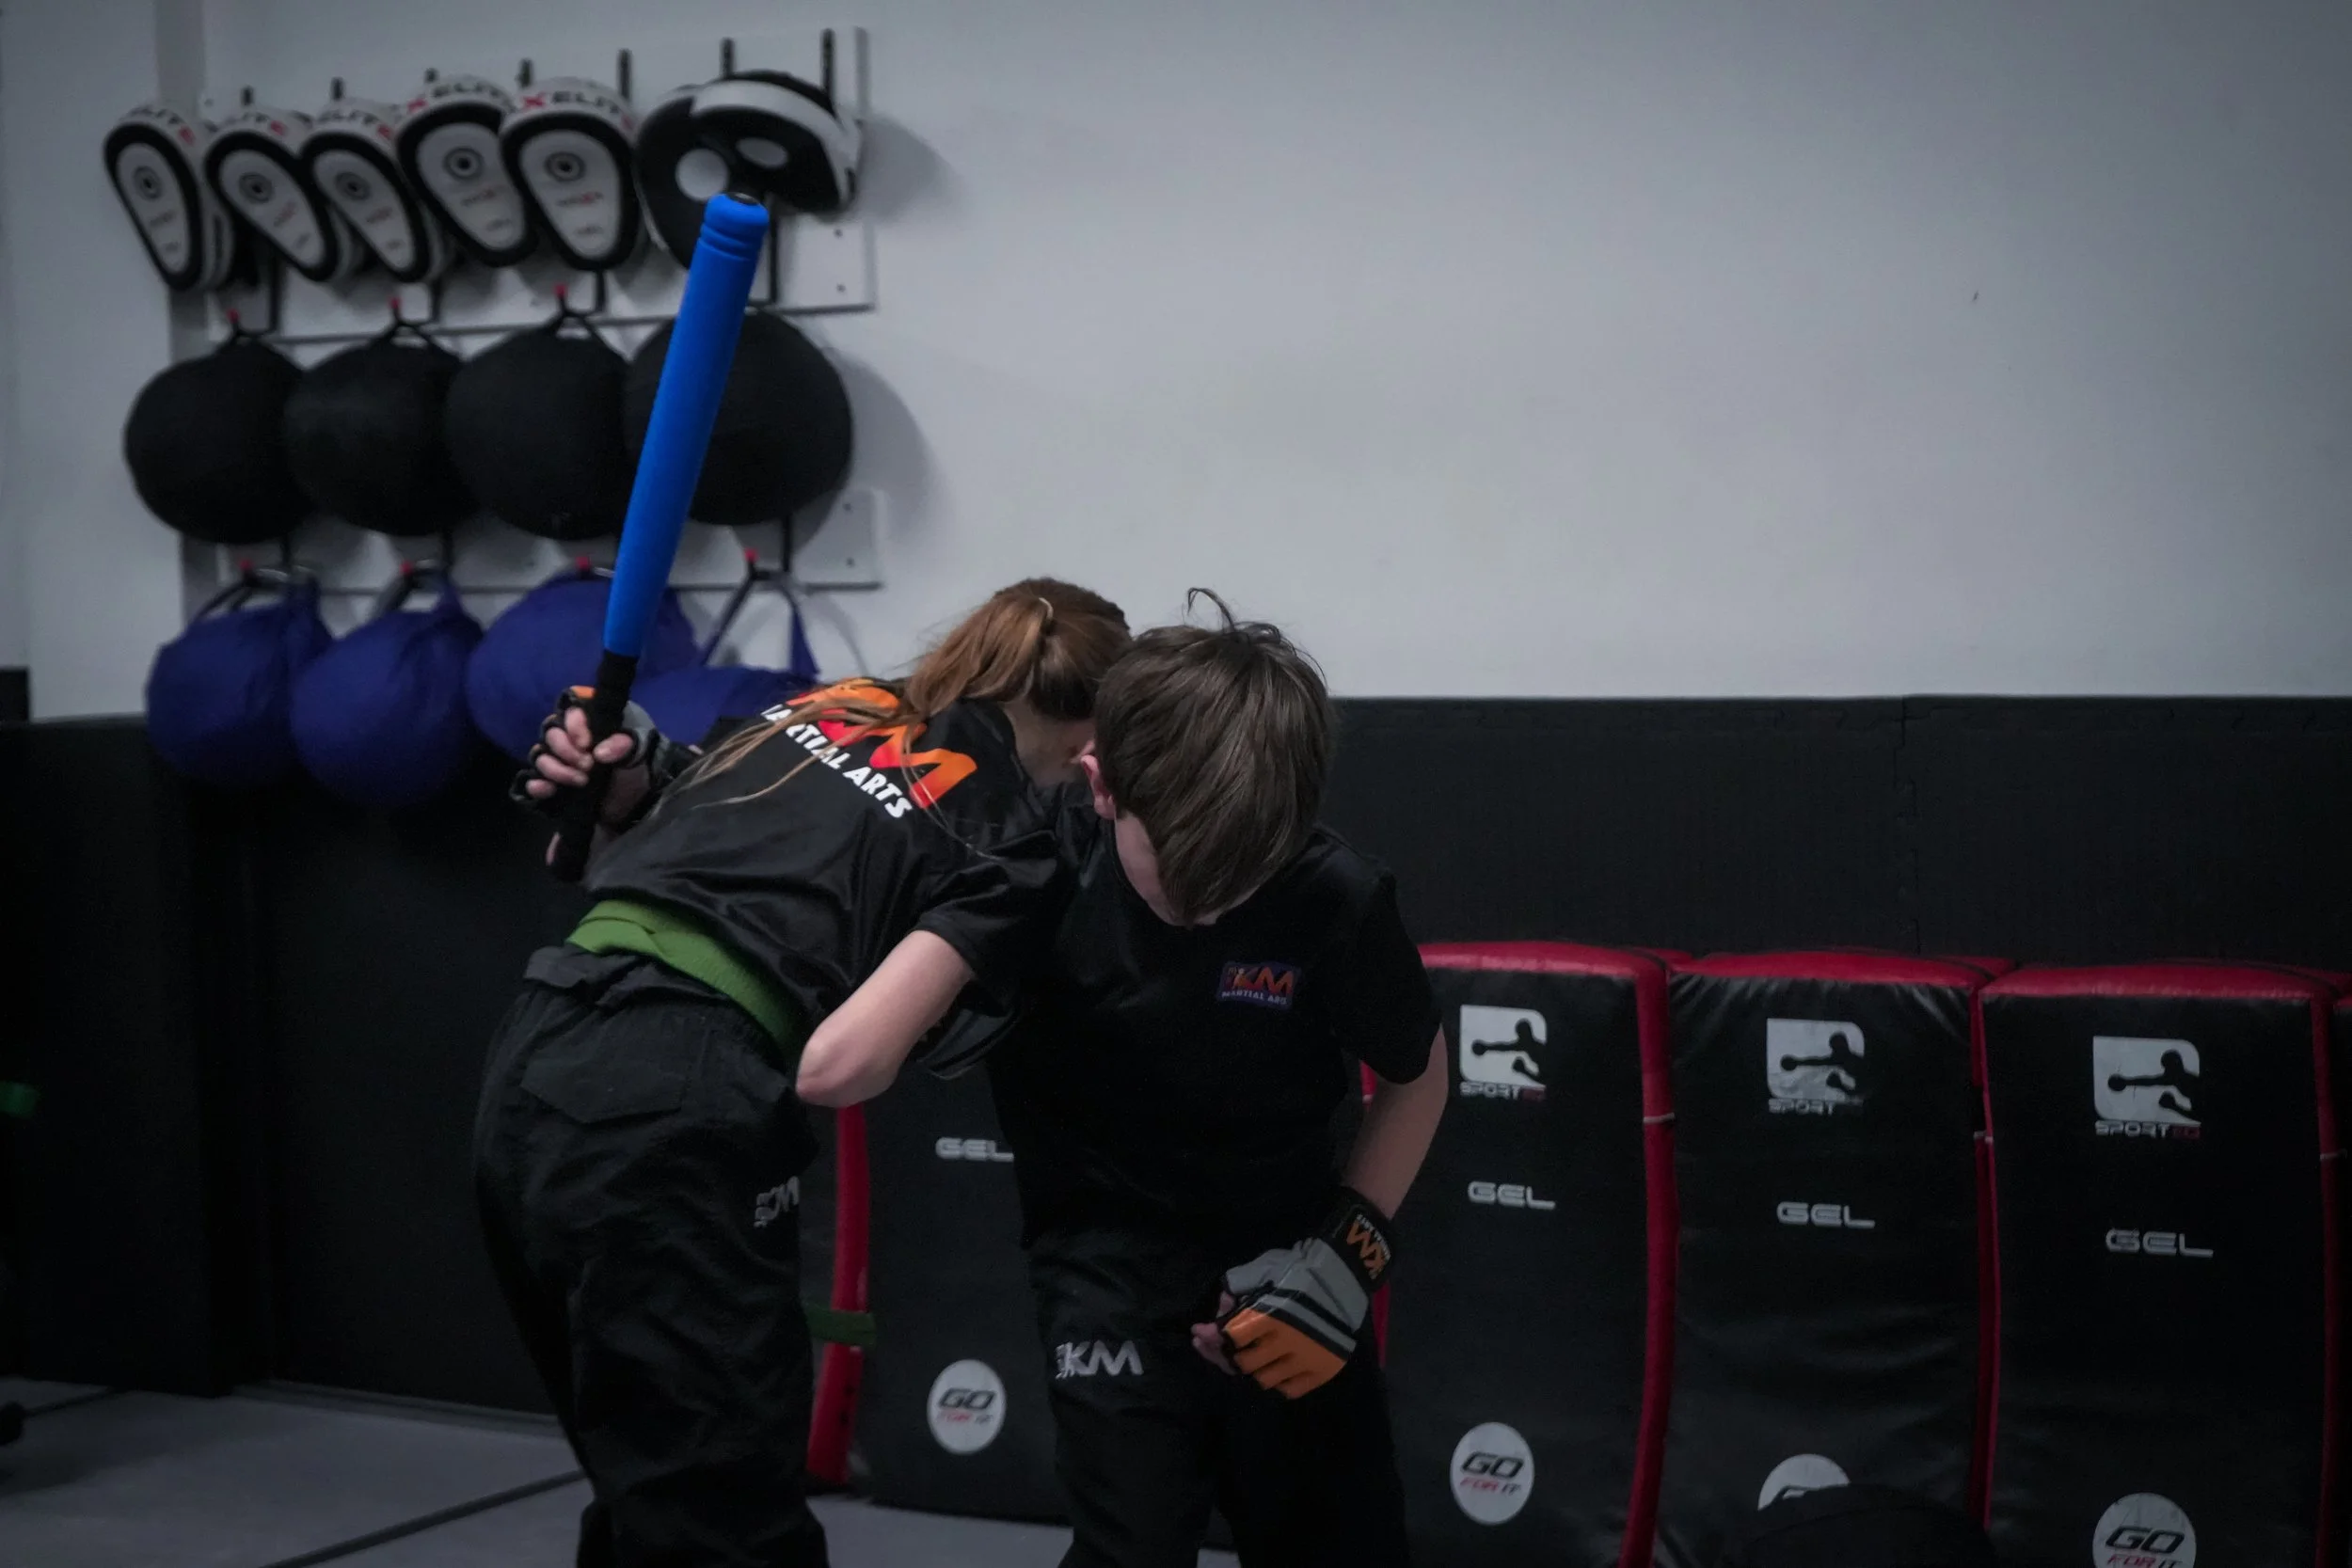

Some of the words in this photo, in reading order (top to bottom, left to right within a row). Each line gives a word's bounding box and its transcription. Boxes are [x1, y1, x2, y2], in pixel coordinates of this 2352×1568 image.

[842, 766, 913, 818] ARTS
[935, 1136, 1014, 1164] GEL
[1468, 1180, 1557, 1211] GEL
[1776, 1201, 1875, 1229] GEL
[2106, 1227, 2214, 1259] GEL
[940, 1388, 995, 1410] GO
[1462, 1451, 1524, 1479] GO
[2106, 1527, 2185, 1553] GO
[2107, 1554, 2156, 1568] FOR
